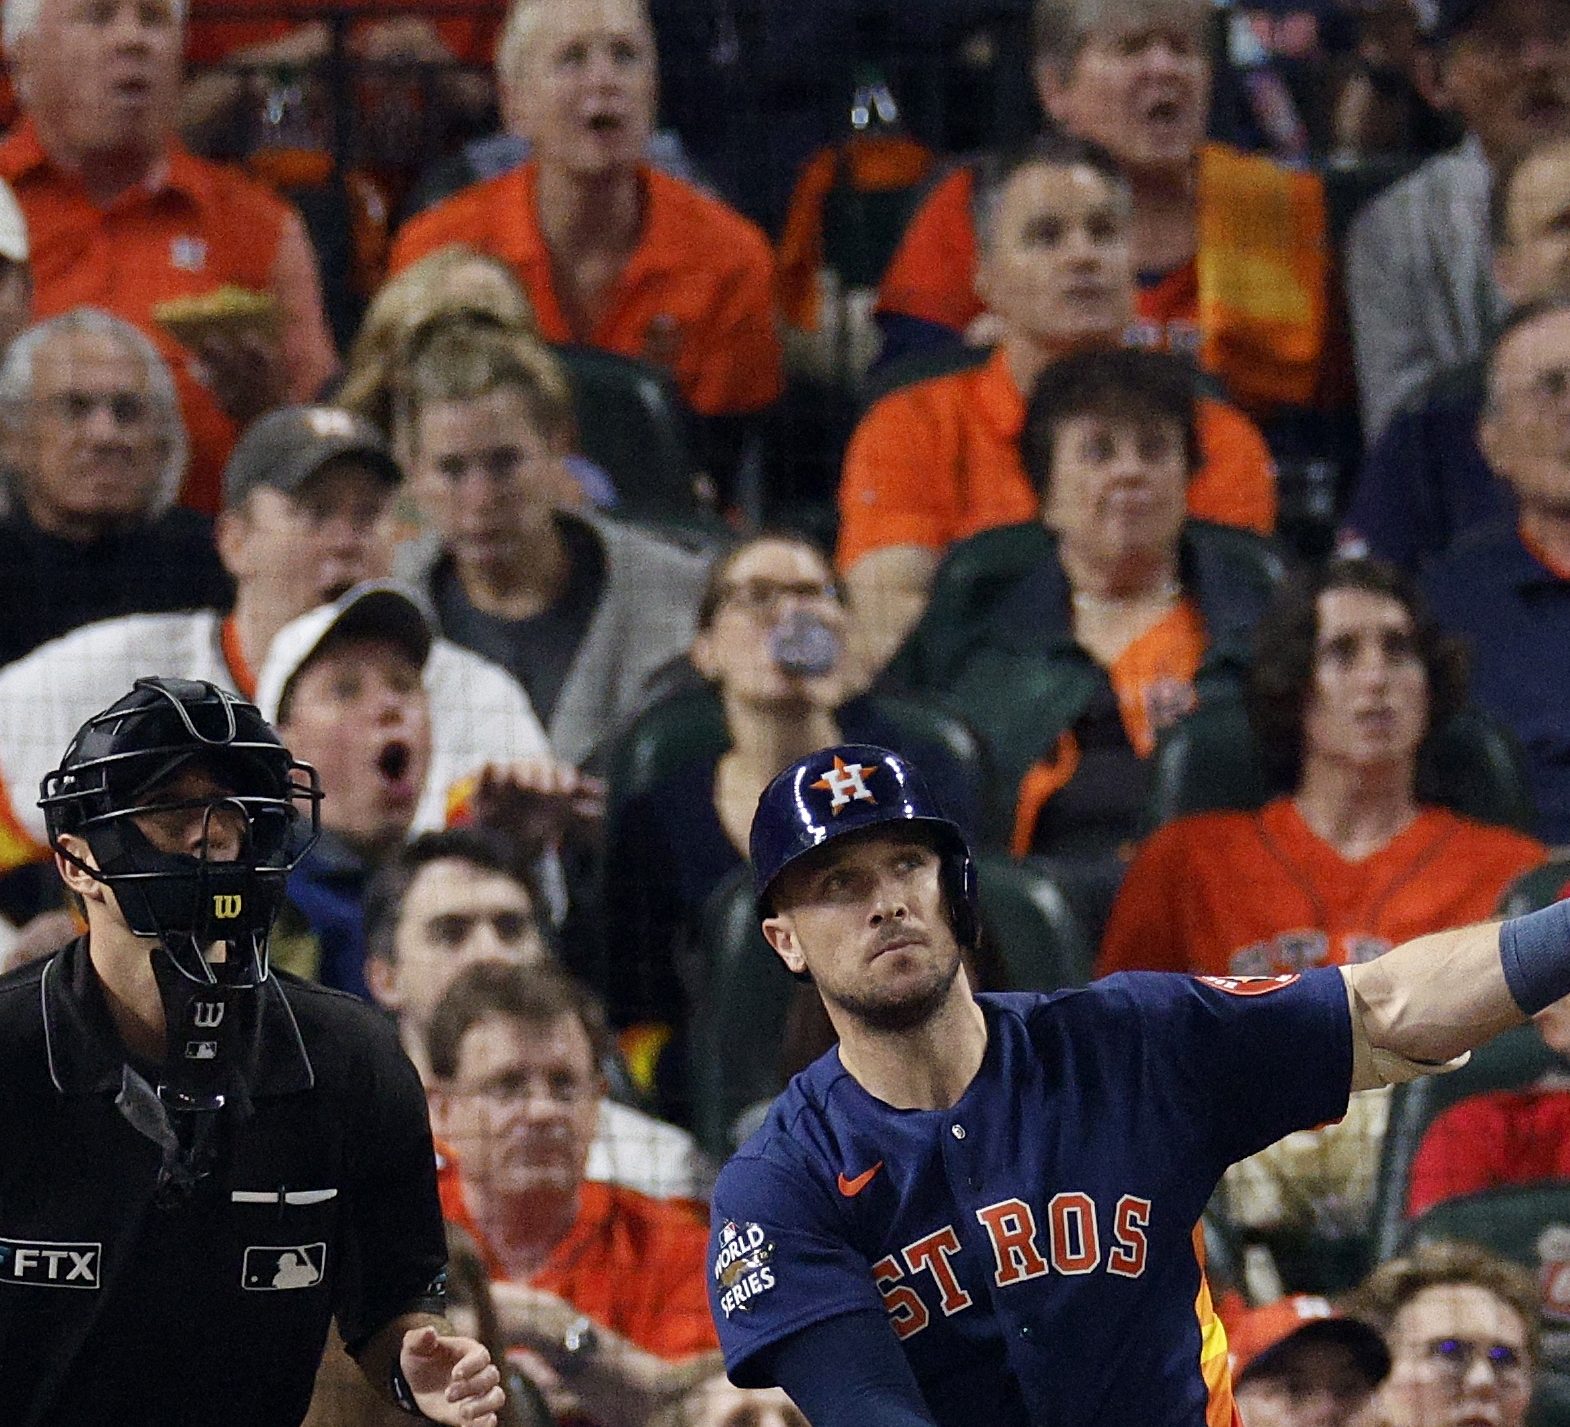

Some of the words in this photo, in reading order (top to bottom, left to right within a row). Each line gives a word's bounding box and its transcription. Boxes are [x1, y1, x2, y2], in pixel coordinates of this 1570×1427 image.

[820, 764, 872, 807] H
[213, 895, 242, 919] W
[193, 1002, 225, 1028] W
[13, 1249, 97, 1281] FTX
[715, 1225, 765, 1280] WORLD
[872, 1191, 1151, 1341] STROS
[720, 1267, 775, 1319] SERIES
